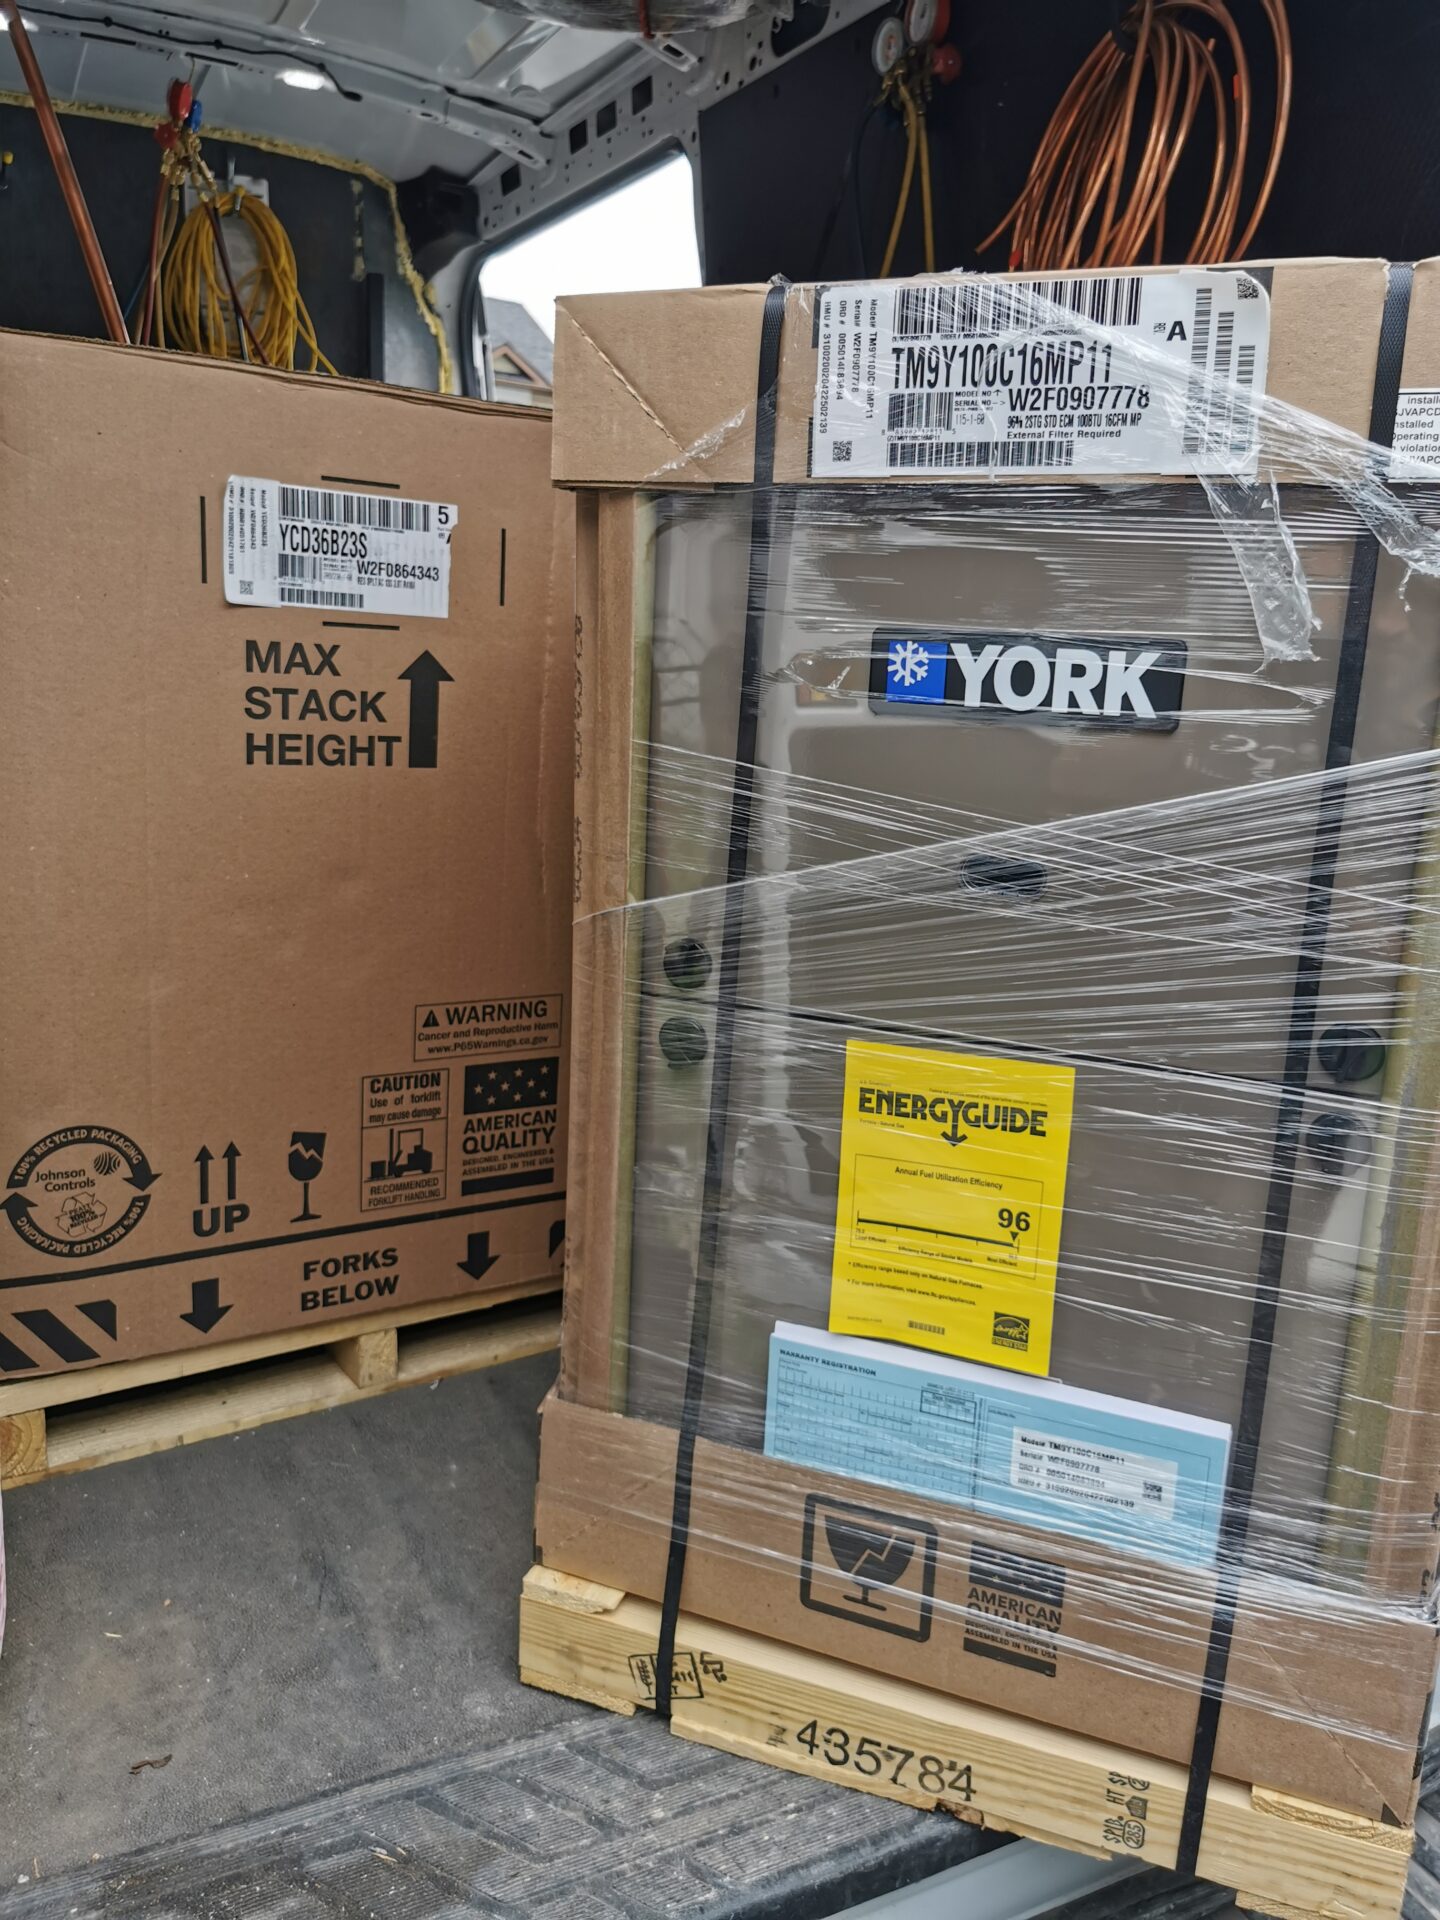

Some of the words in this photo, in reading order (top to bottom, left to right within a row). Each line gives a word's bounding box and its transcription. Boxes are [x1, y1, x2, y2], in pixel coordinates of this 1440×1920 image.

[839, 300, 847, 318] ORD
[1166, 320, 1187, 341] A
[891, 340, 1113, 389] TM9Y100C16MP11
[1008, 384, 1150, 411] W2F0907778
[1043, 414, 1058, 429] STD
[1059, 414, 1075, 428] ECM
[1129, 412, 1142, 427] MP
[1395, 420, 1434, 429] nstalled
[1006, 430, 1045, 439] External
[1048, 430, 1074, 439] Filter
[1077, 430, 1122, 440] Required
[438, 505, 449, 524] 5
[279, 523, 368, 559] YCD36B23S
[357, 560, 440, 582] W2F0864343
[245, 639, 342, 677] MAX
[950, 642, 1163, 719] YORK
[243, 686, 388, 723] STACK
[245, 732, 402, 767] HEIGHT
[445, 999, 548, 1026] WARNING
[417, 1028, 451, 1042] Cancer
[453, 1027, 471, 1039] and
[473, 1023, 532, 1038] Reproductive
[533, 1020, 559, 1032] Harm
[427, 1034, 550, 1055] www.P65Warnings.ca.gov
[370, 1071, 442, 1094] CAUTION
[370, 1096, 388, 1109] Use
[394, 1093, 405, 1107] of
[410, 1090, 442, 1105] forklift
[858, 1086, 1049, 1140] ENERGYGUIDE
[368, 1112, 386, 1125] may
[387, 1109, 411, 1122] cause
[411, 1106, 442, 1121] damage
[463, 1108, 557, 1135] AMERICAN
[462, 1126, 557, 1155] QUALITY
[13, 1154, 37, 1181] 100%
[34, 1128, 88, 1156] RECYCLED
[90, 1128, 143, 1166] PACKAGING
[462, 1163, 508, 1177] ASSEMBLED
[510, 1160, 521, 1170] IN
[522, 1158, 537, 1168] THE
[35, 1168, 86, 1184] Johnson
[44, 1176, 96, 1194] Controls
[369, 1177, 440, 1196] RECOMMENDED
[895, 1166, 919, 1177] Annual
[919, 1169, 934, 1179] Fuel
[935, 1171, 969, 1184] Utilization
[969, 1176, 1003, 1190] Efficiency
[368, 1193, 404, 1208] FORKLIFT
[404, 1188, 441, 1203] HANDLING
[125, 1199, 145, 1227] 100%
[192, 1203, 250, 1238] UP
[997, 1207, 1031, 1233] 96
[16, 1217, 72, 1254] PACKAGING
[73, 1225, 126, 1255] RECYCLED
[303, 1247, 399, 1282] FORKS
[301, 1275, 400, 1312] BELOW
[779, 1348, 821, 1364] WARRANTY
[821, 1358, 877, 1377] REGISTRATION
[967, 1587, 1062, 1626] AMERICAN
[965, 1628, 1010, 1647] ASSEMBLED
[1011, 1641, 1021, 1650] IN
[1023, 1644, 1039, 1655] THE
[1041, 1648, 1058, 1660] USA
[796, 1719, 977, 1802] 435784
[1105, 1788, 1126, 1806] HT
[1125, 1823, 1142, 1846] 285
